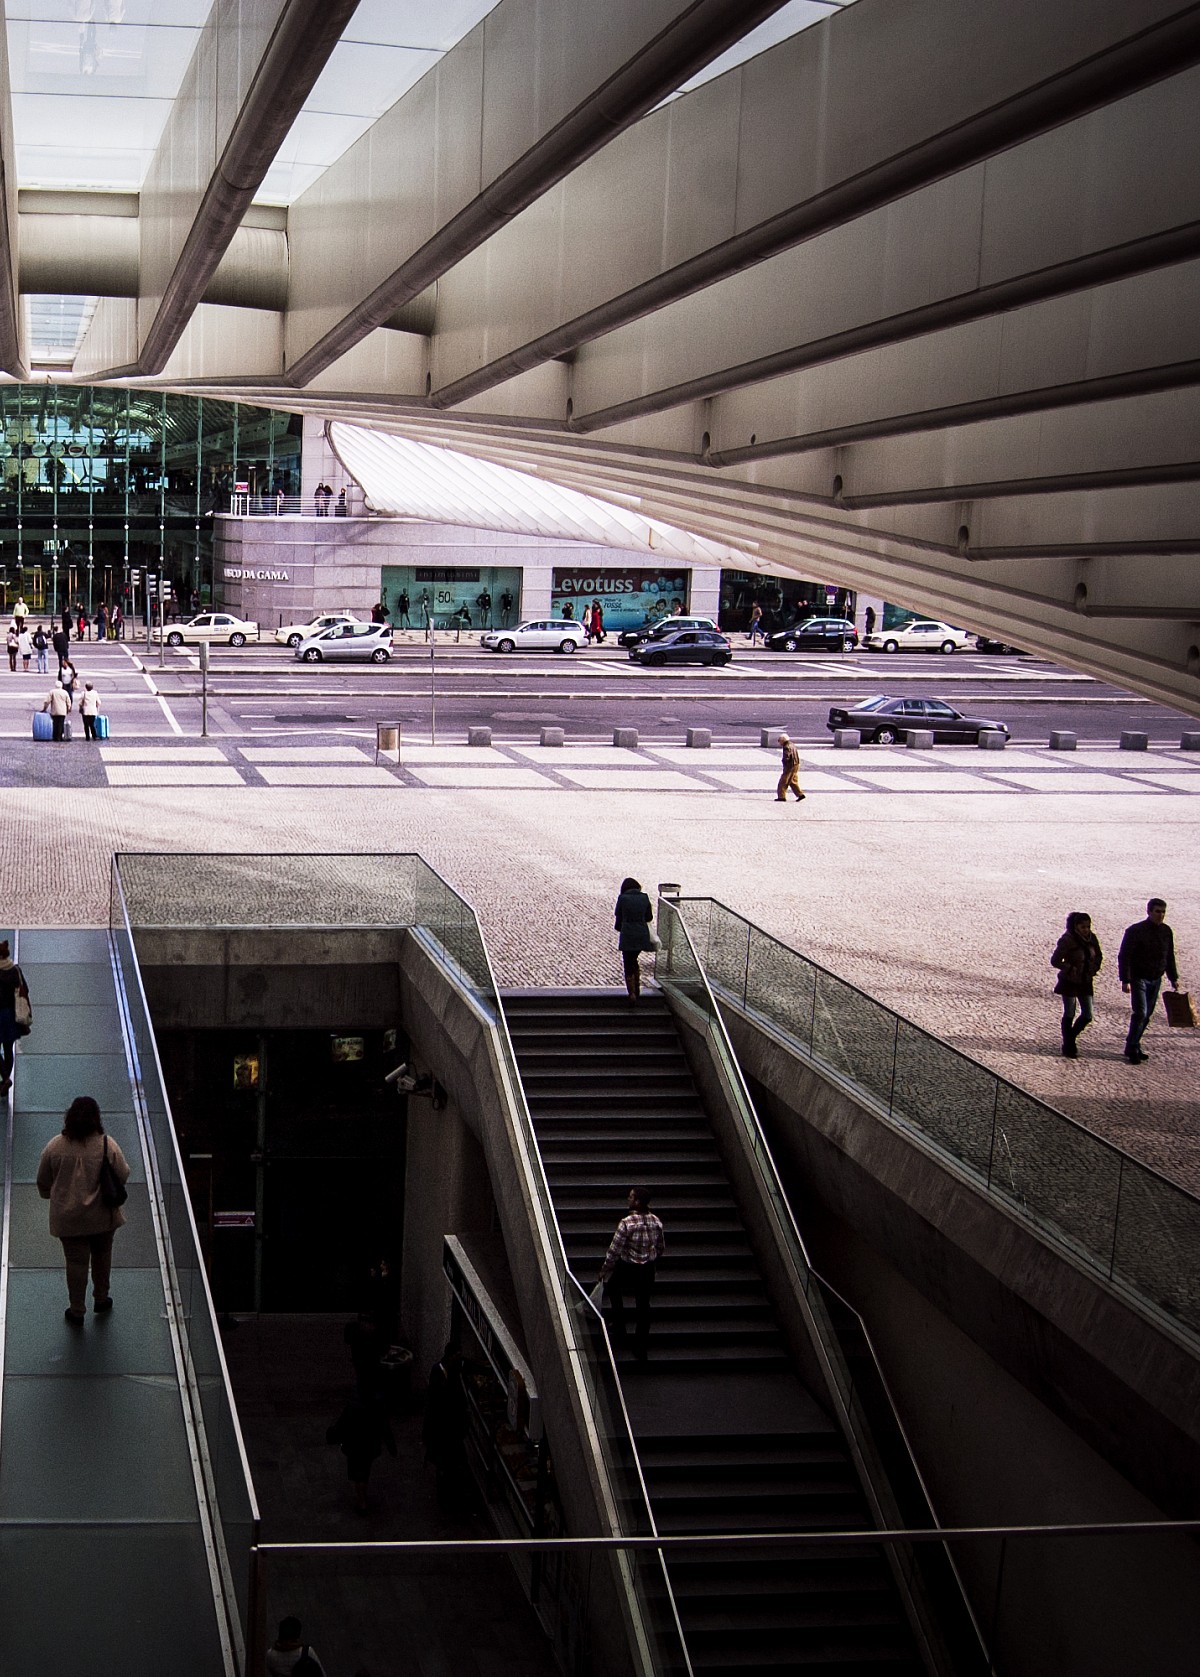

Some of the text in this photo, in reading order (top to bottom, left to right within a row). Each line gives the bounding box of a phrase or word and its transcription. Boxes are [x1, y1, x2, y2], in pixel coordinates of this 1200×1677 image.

[243, 569, 256, 580] DA
[257, 570, 289, 580] GAMA
[552, 574, 634, 592] Levotuss
